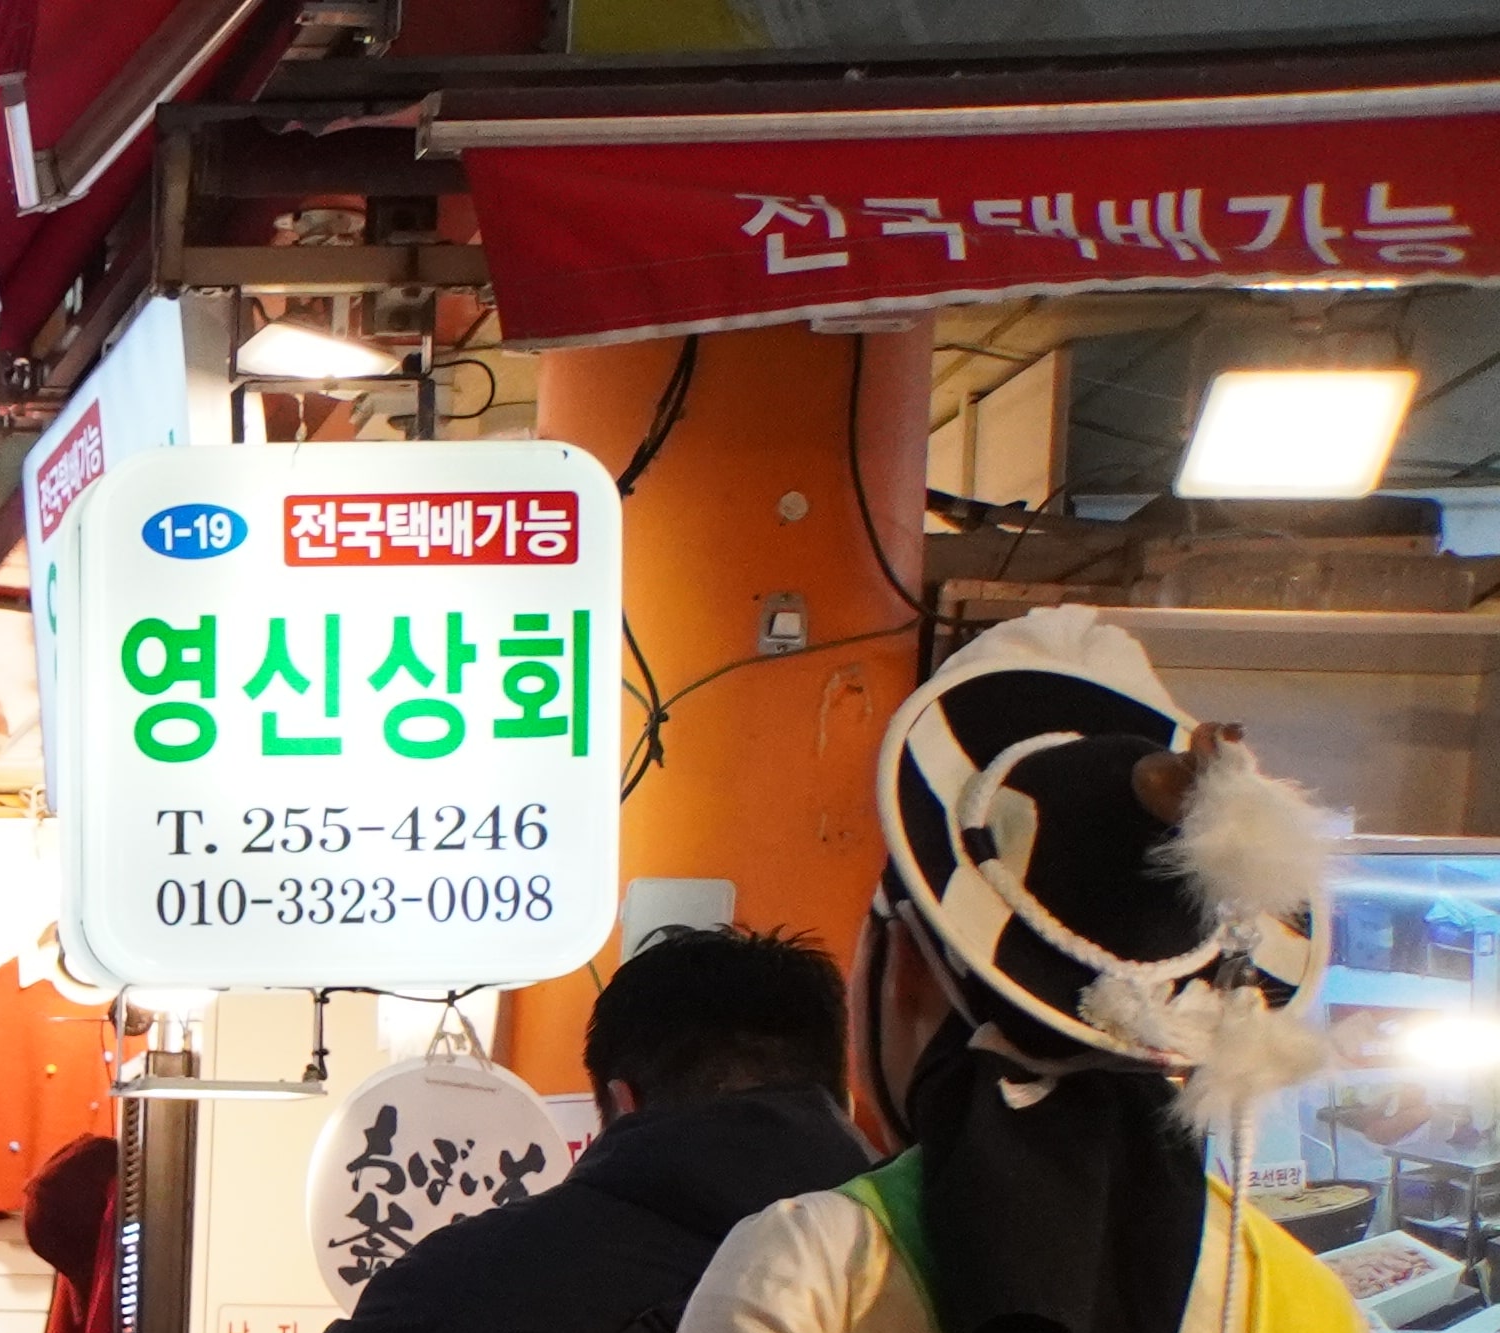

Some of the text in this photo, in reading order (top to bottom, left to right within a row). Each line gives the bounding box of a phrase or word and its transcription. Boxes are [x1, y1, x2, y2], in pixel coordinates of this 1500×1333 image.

[736, 183, 1473, 276] 전국택배가능
[158, 513, 233, 551] 1-19
[290, 499, 572, 560] 전국택배가능
[120, 609, 591, 763] 영신상회
[156, 803, 550, 856] T. 255-4246
[155, 874, 554, 927] 010-3323-0098
